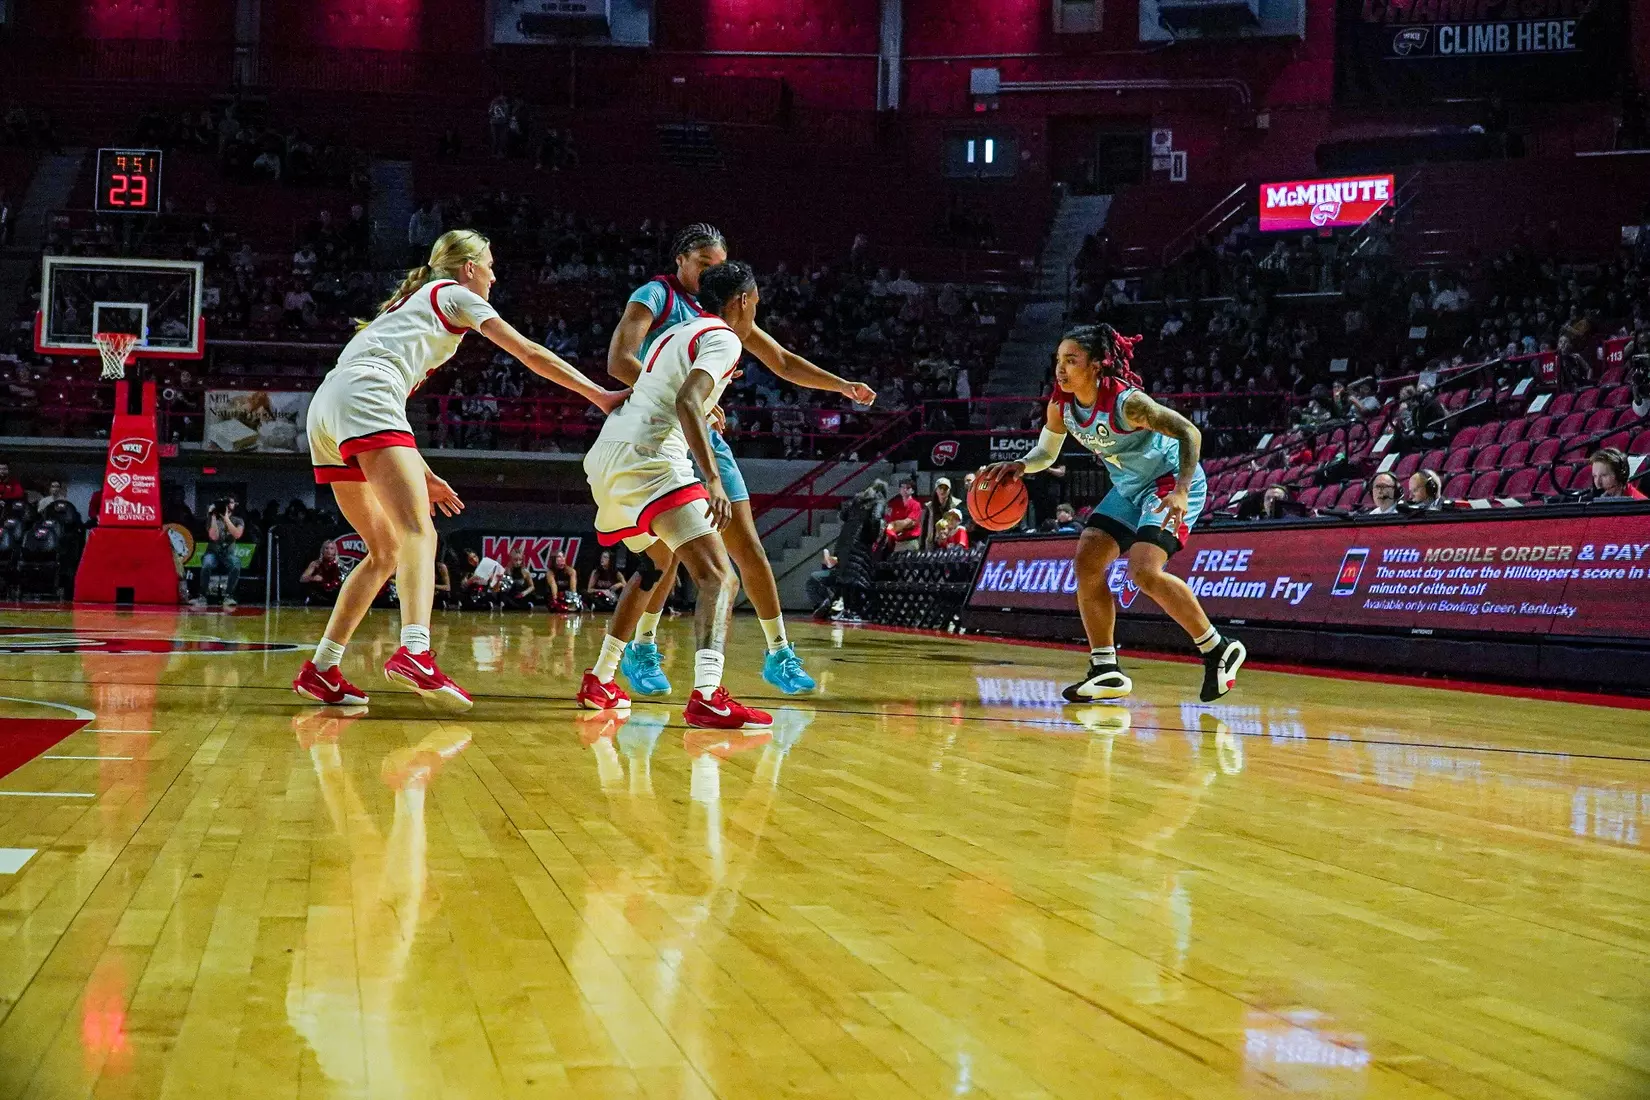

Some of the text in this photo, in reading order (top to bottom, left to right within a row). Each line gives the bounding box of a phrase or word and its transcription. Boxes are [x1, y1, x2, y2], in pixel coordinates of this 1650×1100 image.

[1439, 20, 1576, 54] CLIMB HERE
[109, 174, 148, 206] 23
[1266, 179, 1389, 208] McMINUTE
[989, 437, 1039, 451] LEACH
[482, 535, 583, 572] WKU
[1191, 549, 1254, 572] FREE
[1382, 543, 1650, 563] With MOBILE ORDER & PAY
[976, 559, 1129, 594] McMINUE
[1375, 566, 1397, 578] The
[1395, 567, 1423, 579] next
[1423, 566, 1447, 581] day
[1446, 566, 1479, 579] after
[1479, 566, 1502, 579] the
[1503, 566, 1581, 581] Hilltoppers
[1581, 568, 1626, 579] score
[1628, 565, 1645, 579] in
[1185, 576, 1313, 605] Medium Fry
[1368, 581, 1489, 596] minute of either half
[1362, 599, 1578, 619] Available only in Bowling Green, Kentucky
